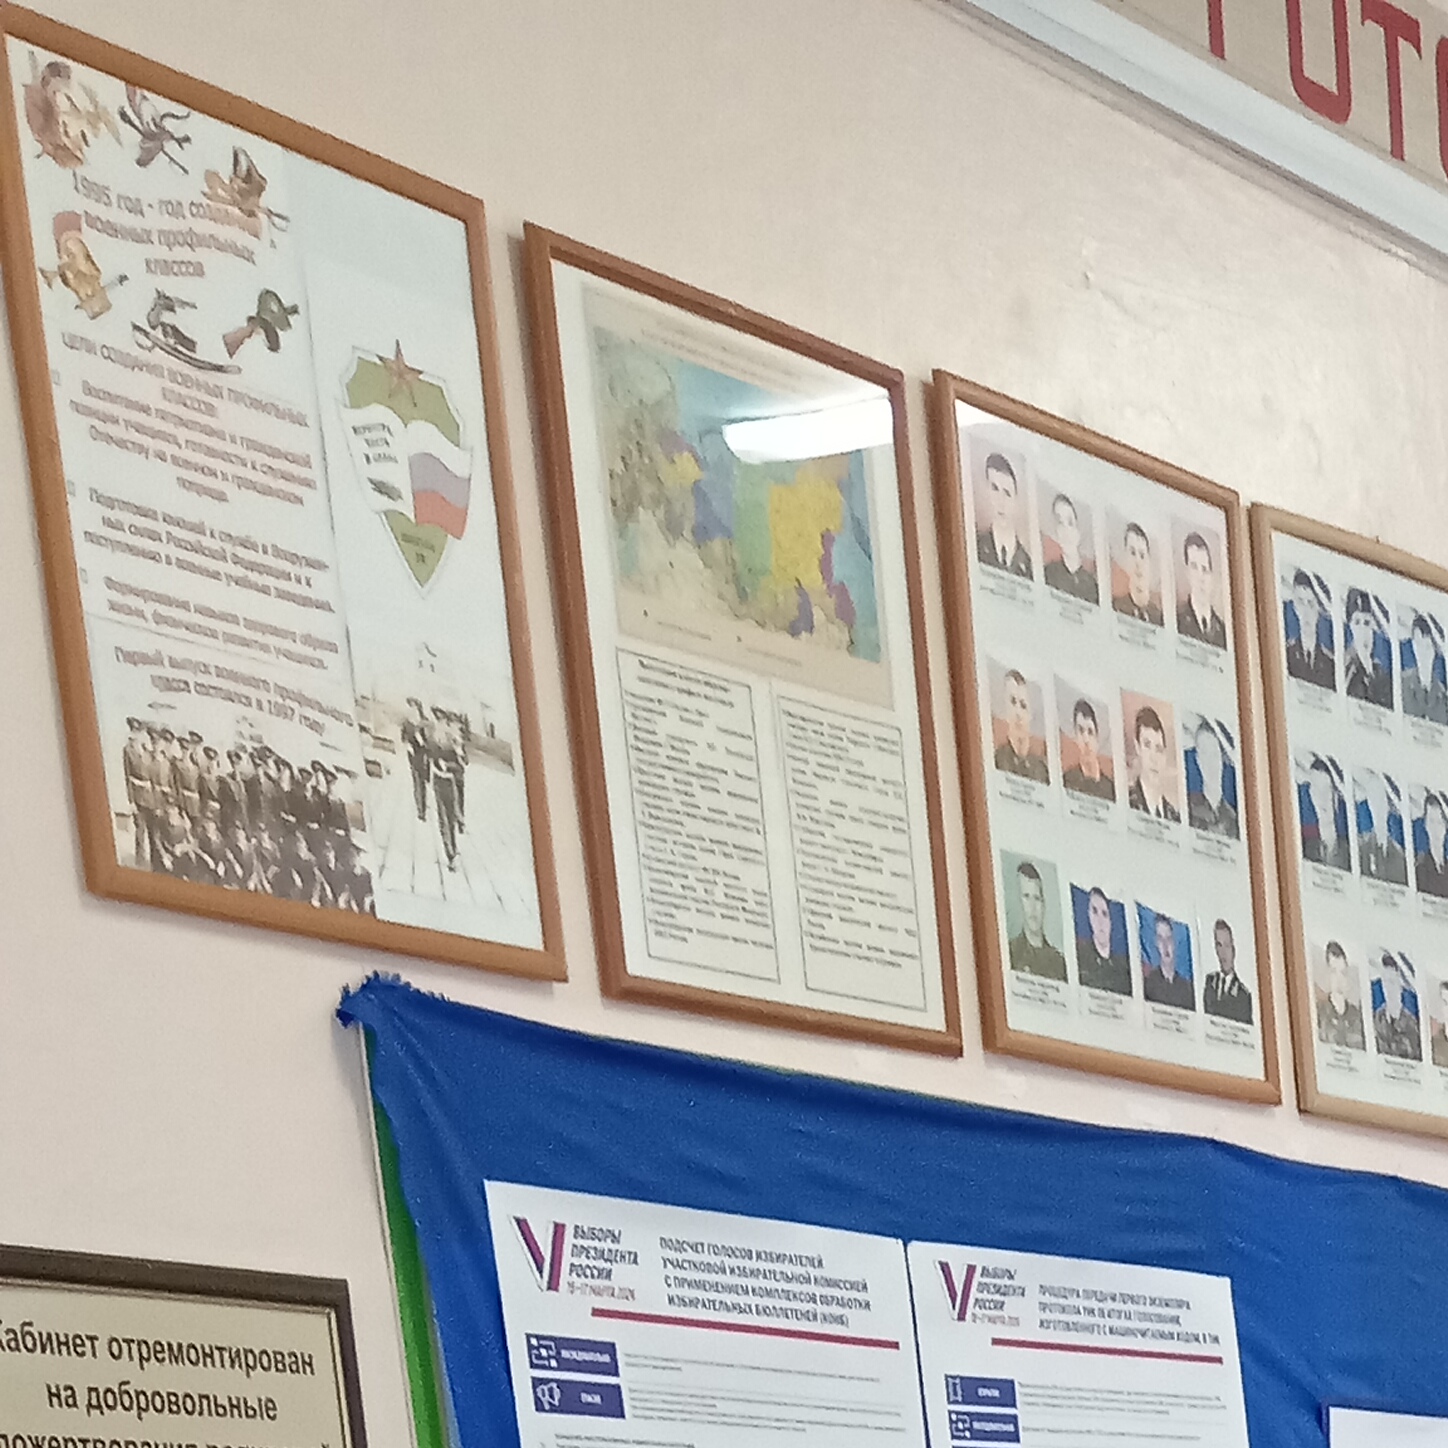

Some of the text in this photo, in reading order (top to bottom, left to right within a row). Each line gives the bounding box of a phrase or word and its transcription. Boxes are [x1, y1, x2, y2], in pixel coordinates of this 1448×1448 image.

[573, 1224, 622, 1245] ВЫБОРЫ
[571, 1243, 640, 1267] ПРЕЗИДЕНТА
[659, 1236, 825, 1270] ПОДСЧЕТ ГОЛОСОВ ИЗБИРАТЕЛЕЙ
[568, 1262, 613, 1282] РОССИИ
[661, 1256, 869, 1294] УЧАСТКОВОЙ ИЗБИРАТЕЛЬНОЙ КОМИССИЕЙ
[664, 1274, 872, 1312] С ПРИМЕНЕНИЕМ КОМПЛЕКСОВ ОБРАБОТКИ
[666, 1293, 753, 1317] ИЗБИРАТЕЛЬНЫХ
[754, 1304, 819, 1323] БЮЛЛЕТЕНЕЙ
[107, 1332, 316, 1379] отремонтирован
[46, 1380, 279, 1422] на добровольные
